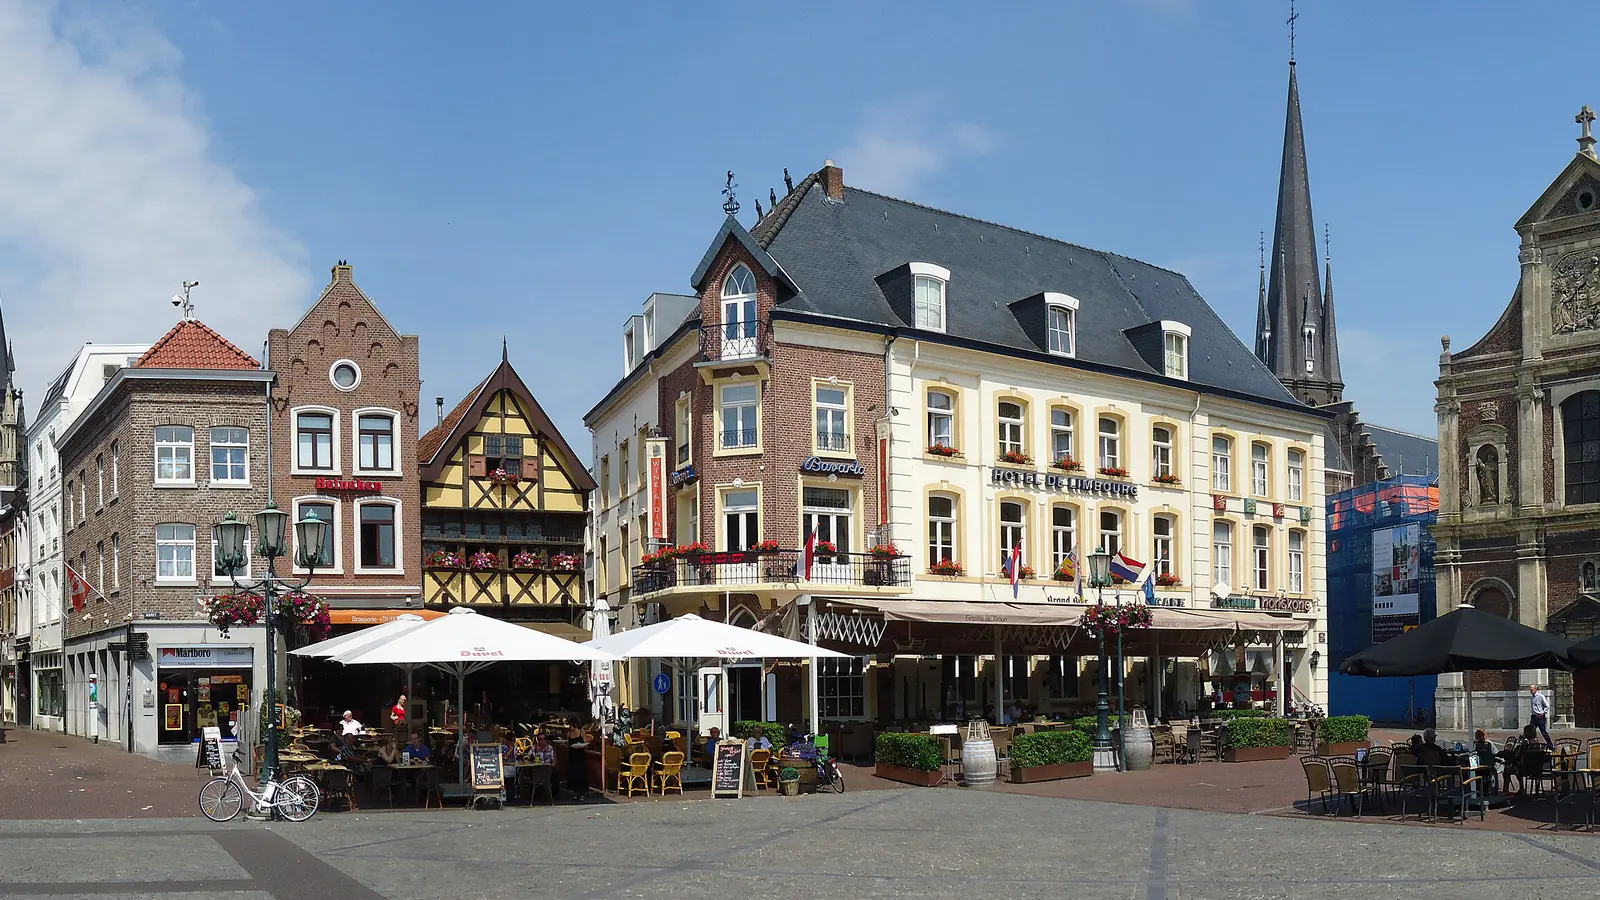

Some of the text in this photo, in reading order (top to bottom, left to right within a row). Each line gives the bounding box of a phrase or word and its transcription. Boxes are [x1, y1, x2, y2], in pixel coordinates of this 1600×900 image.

[316, 477, 382, 490] Heineken
[993, 469, 1138, 496] HOTEL DE LIMBOURG
[652, 460, 661, 534] WINE & DINE
[175, 648, 211, 658] Marlboro
